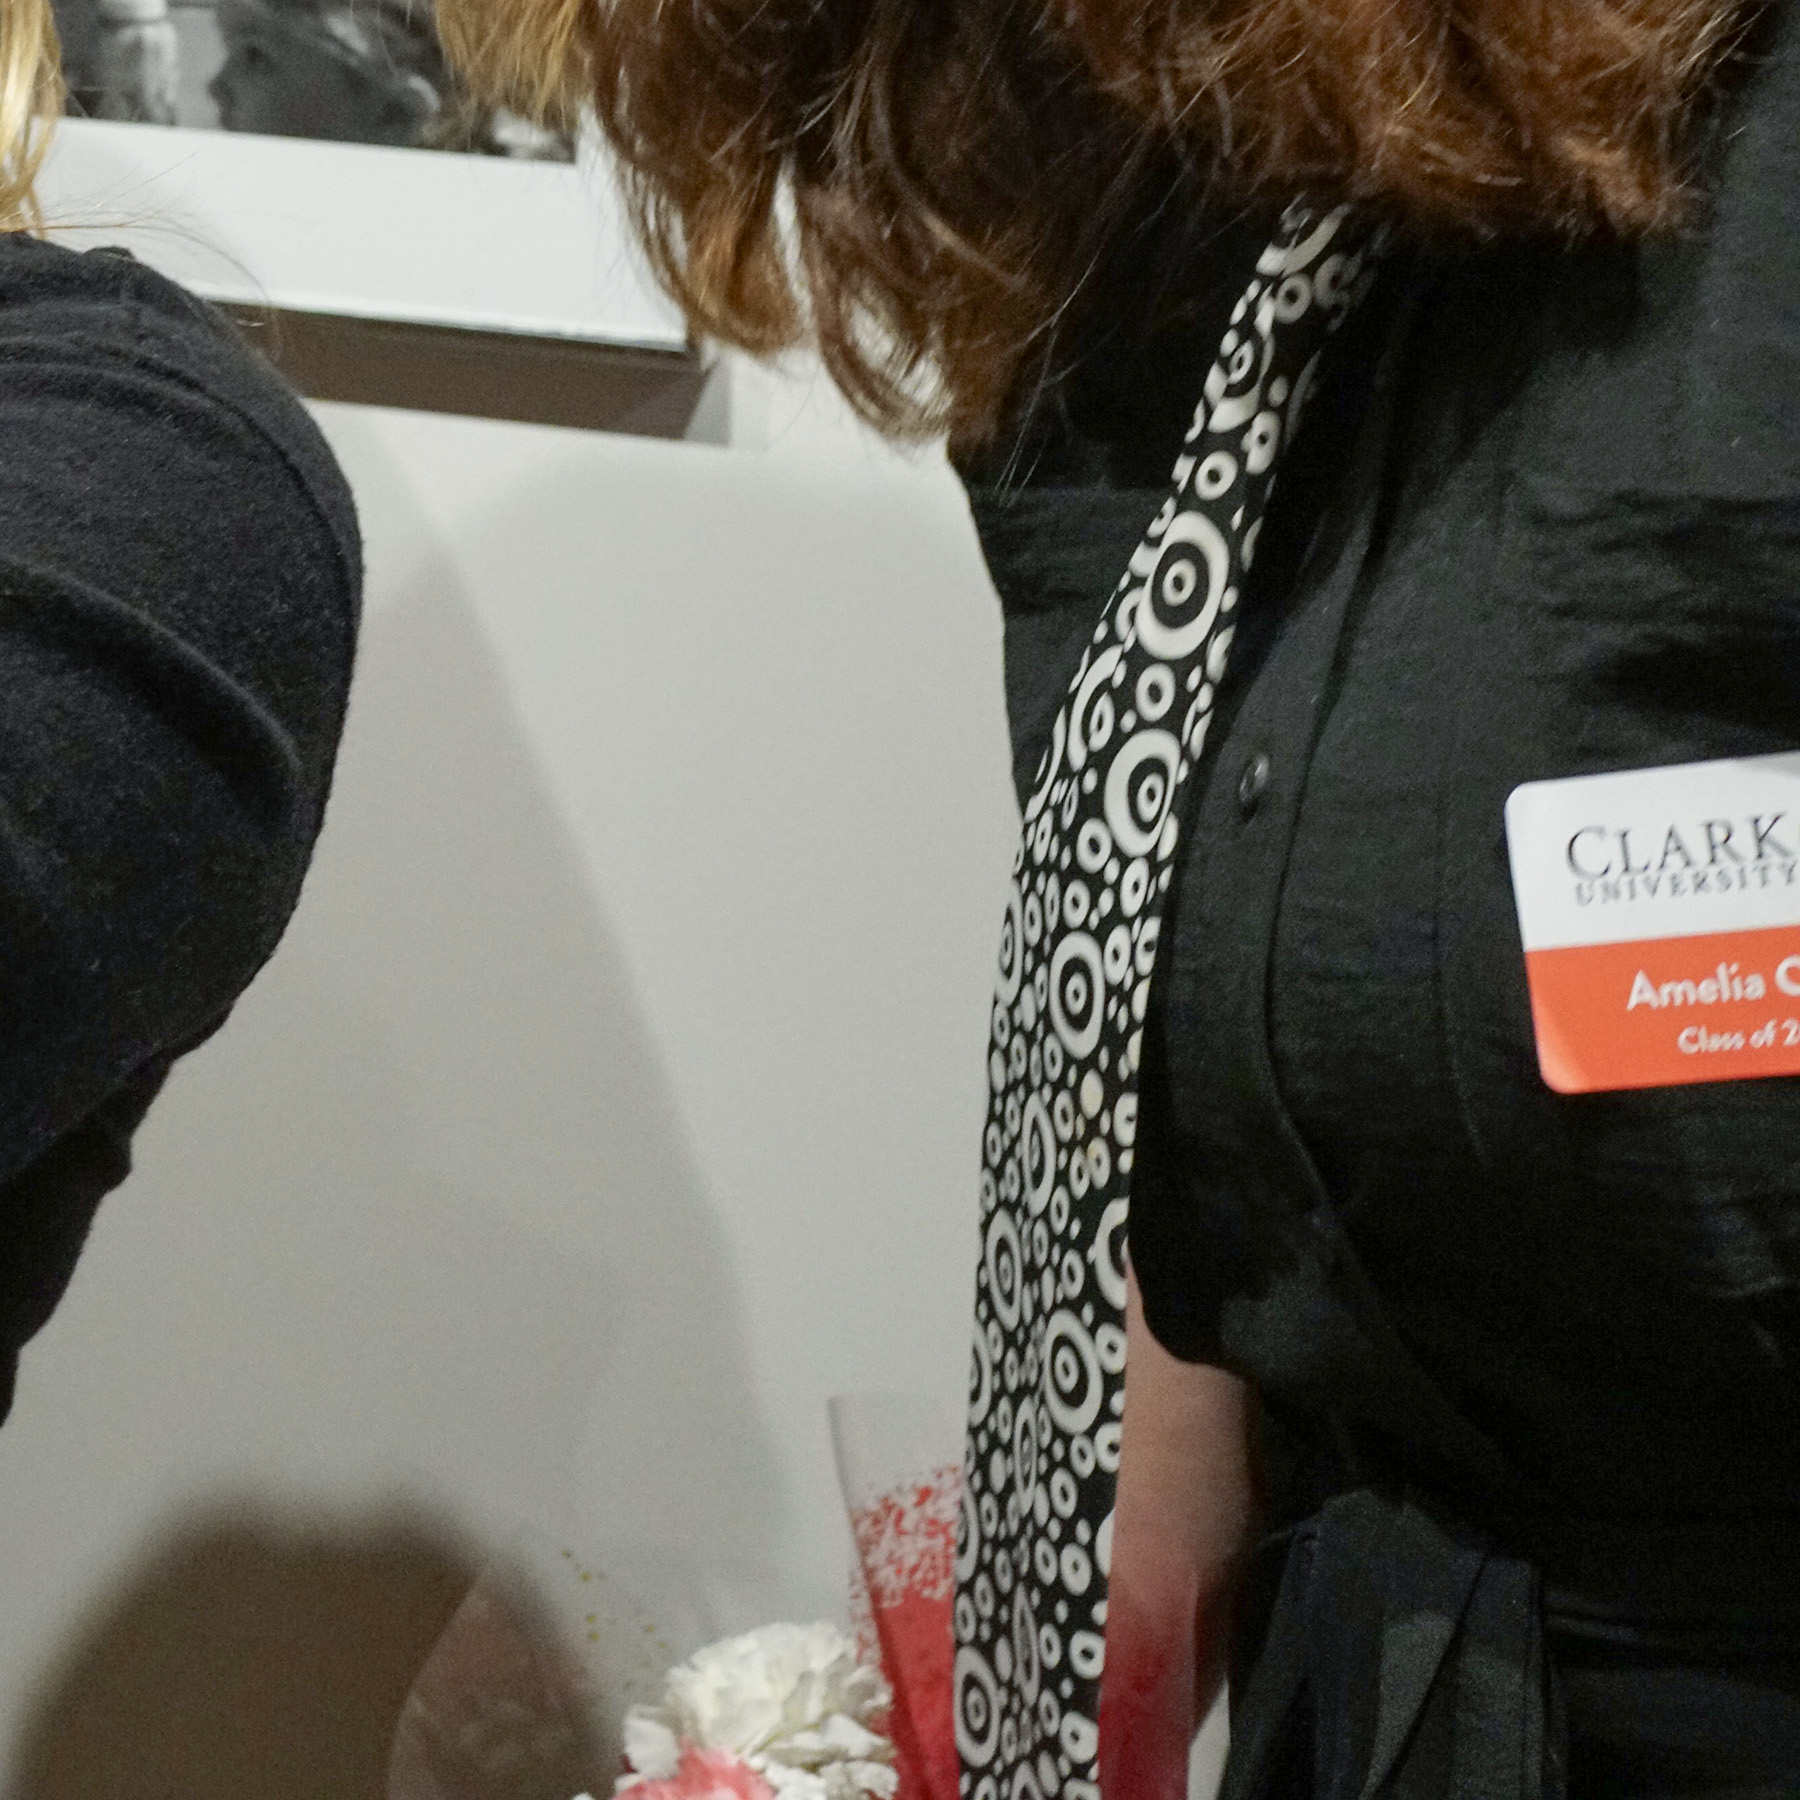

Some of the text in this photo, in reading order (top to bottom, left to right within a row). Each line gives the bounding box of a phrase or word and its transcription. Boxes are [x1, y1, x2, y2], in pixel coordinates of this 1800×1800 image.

[1566, 812, 1795, 880] CLARK
[1576, 861, 1799, 906] UNIVERSITY
[1626, 961, 1766, 1012] Amelia
[1677, 1025, 1745, 1054] Class
[1750, 1018, 1777, 1049] of
